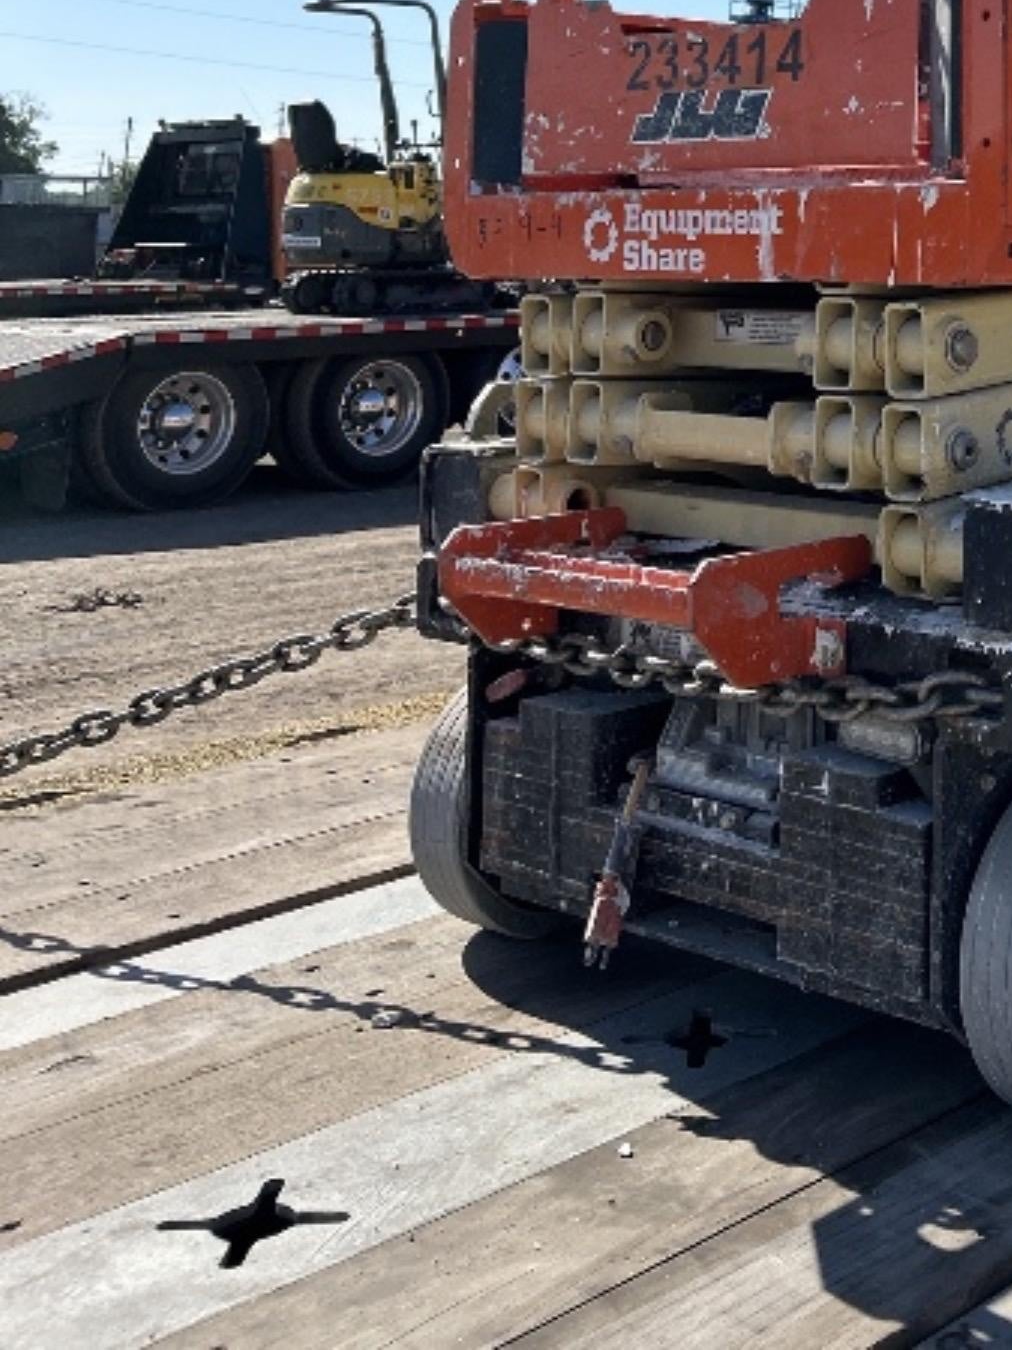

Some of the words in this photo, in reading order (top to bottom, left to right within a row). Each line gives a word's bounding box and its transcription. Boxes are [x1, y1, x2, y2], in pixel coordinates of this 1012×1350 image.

[627, 28, 804, 90] 233414
[630, 86, 774, 145] JLG
[623, 202, 783, 241] Equipment
[623, 240, 706, 272] Share
